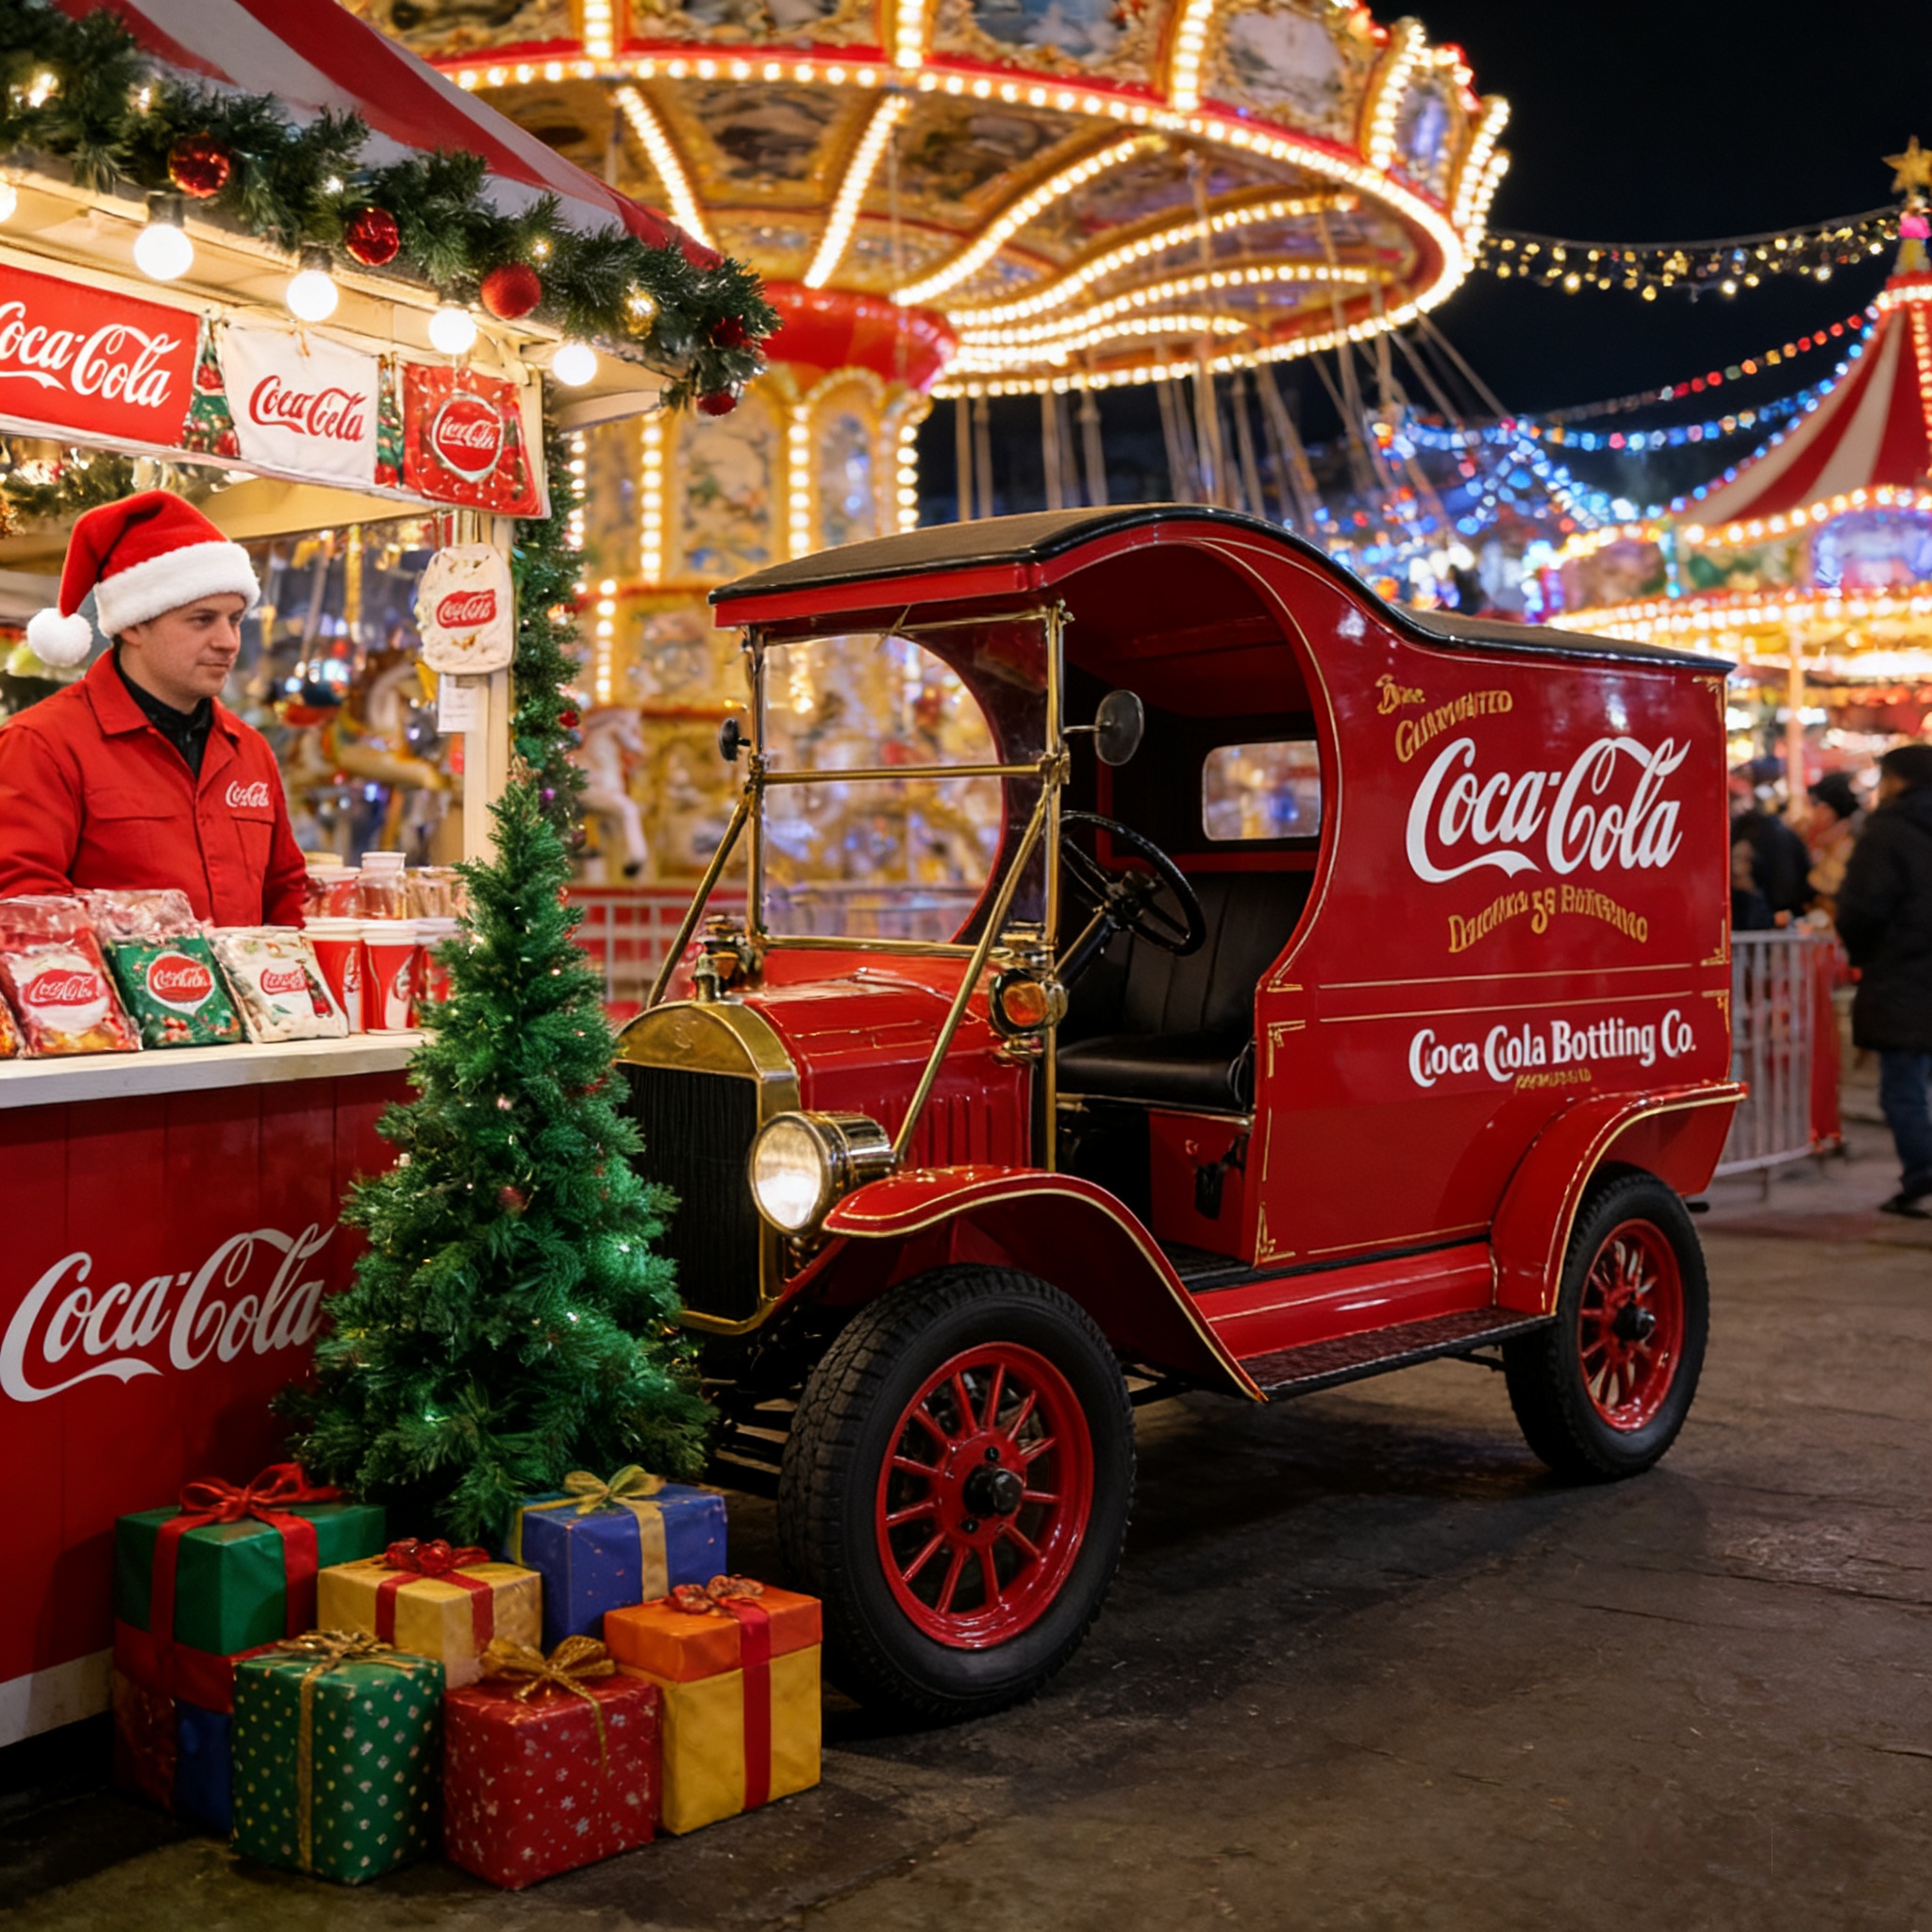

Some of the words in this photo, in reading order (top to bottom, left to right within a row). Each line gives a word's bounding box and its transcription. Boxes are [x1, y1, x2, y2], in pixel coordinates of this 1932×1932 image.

[1406, 737, 1691, 884] Coca-Cola
[1550, 1016, 1656, 1067] Bottling
[1661, 1008, 1697, 1058] Co.
[0, 1223, 337, 1403] Coca-Cola
